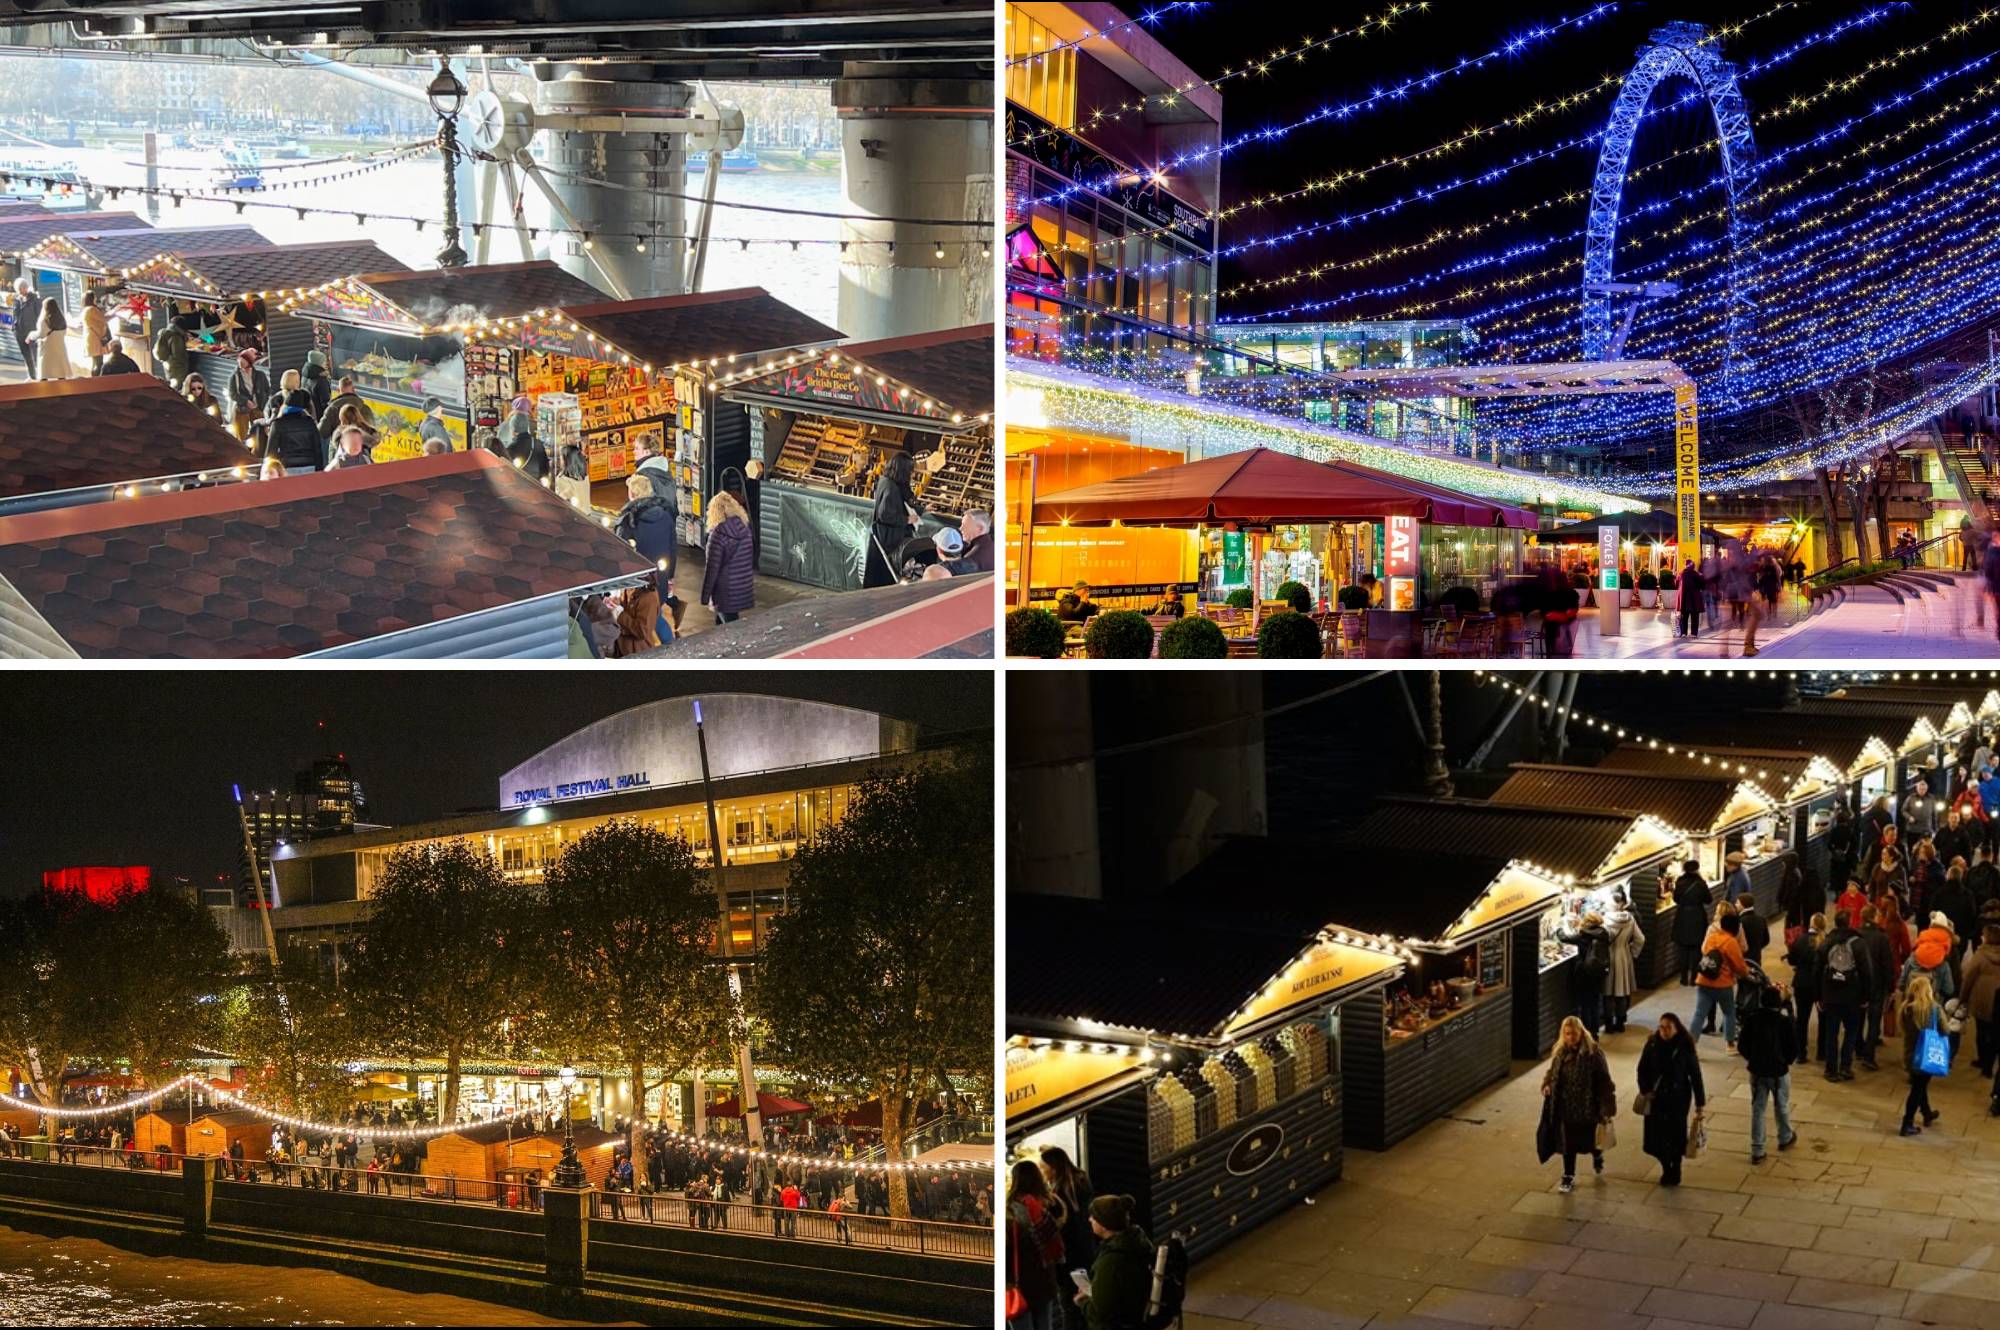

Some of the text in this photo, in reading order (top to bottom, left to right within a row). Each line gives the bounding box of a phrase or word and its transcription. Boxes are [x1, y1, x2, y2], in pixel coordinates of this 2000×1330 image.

[1173, 203, 1208, 233] SOUTHBANK
[1173, 217, 1196, 239] CENTRE
[807, 376, 832, 388] British
[848, 382, 860, 393] Co
[815, 367, 851, 381] The Great
[1680, 405, 1695, 489] WELCOME
[1391, 515, 1409, 567] EAT.
[1603, 528, 1614, 566] FOYLES
[514, 771, 650, 804] ROYAL FESTIVAL HALL
